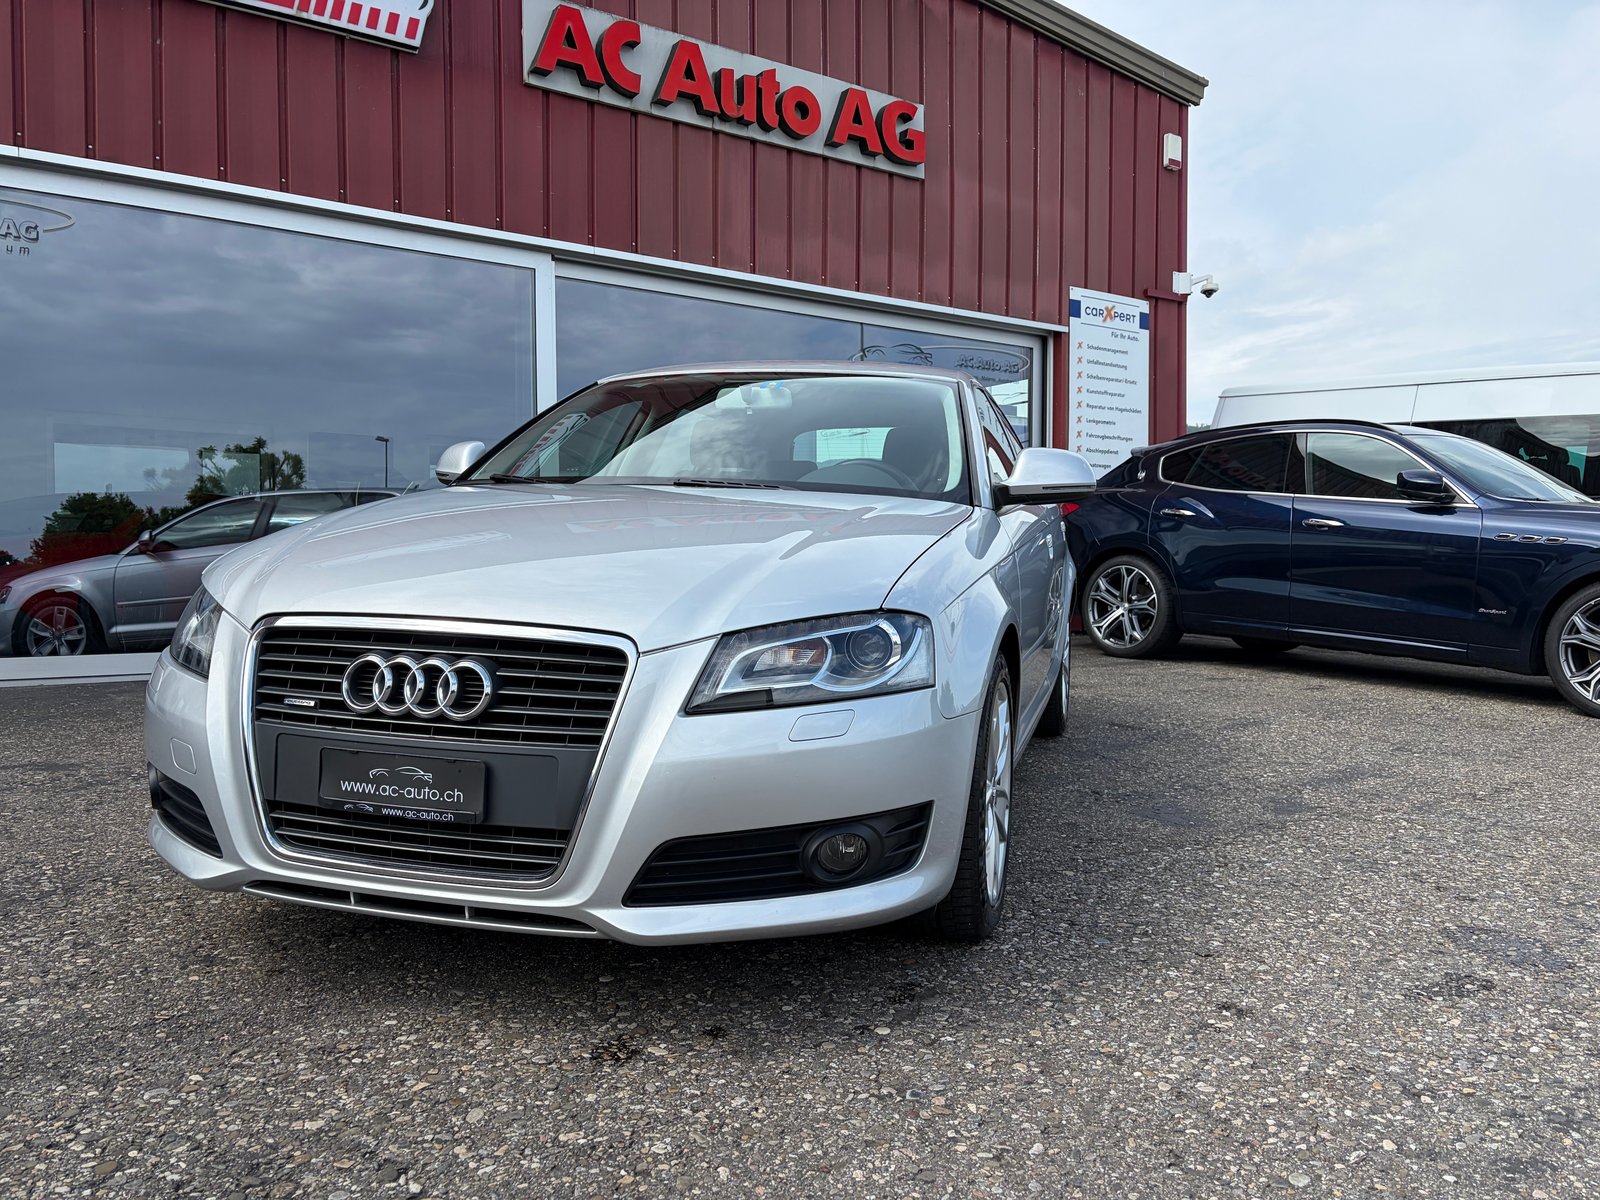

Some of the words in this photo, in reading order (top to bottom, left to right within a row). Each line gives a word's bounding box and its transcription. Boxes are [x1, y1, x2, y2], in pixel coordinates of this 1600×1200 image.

[529, 4, 642, 98] AC
[652, 39, 822, 140] Auto
[825, 87, 926, 167] AG
[1111, 331, 1119, 339] Für
[1086, 343, 1128, 355] Schadenmanagement
[1086, 388, 1125, 398] Kunststoffreparatur
[1086, 417, 1116, 425] Lenkgeometrie
[1085, 447, 1119, 456] Abschleppdienst
[340, 780, 465, 803] www.ac-auto.ch
[381, 807, 455, 822] www.ac-auto.ch
